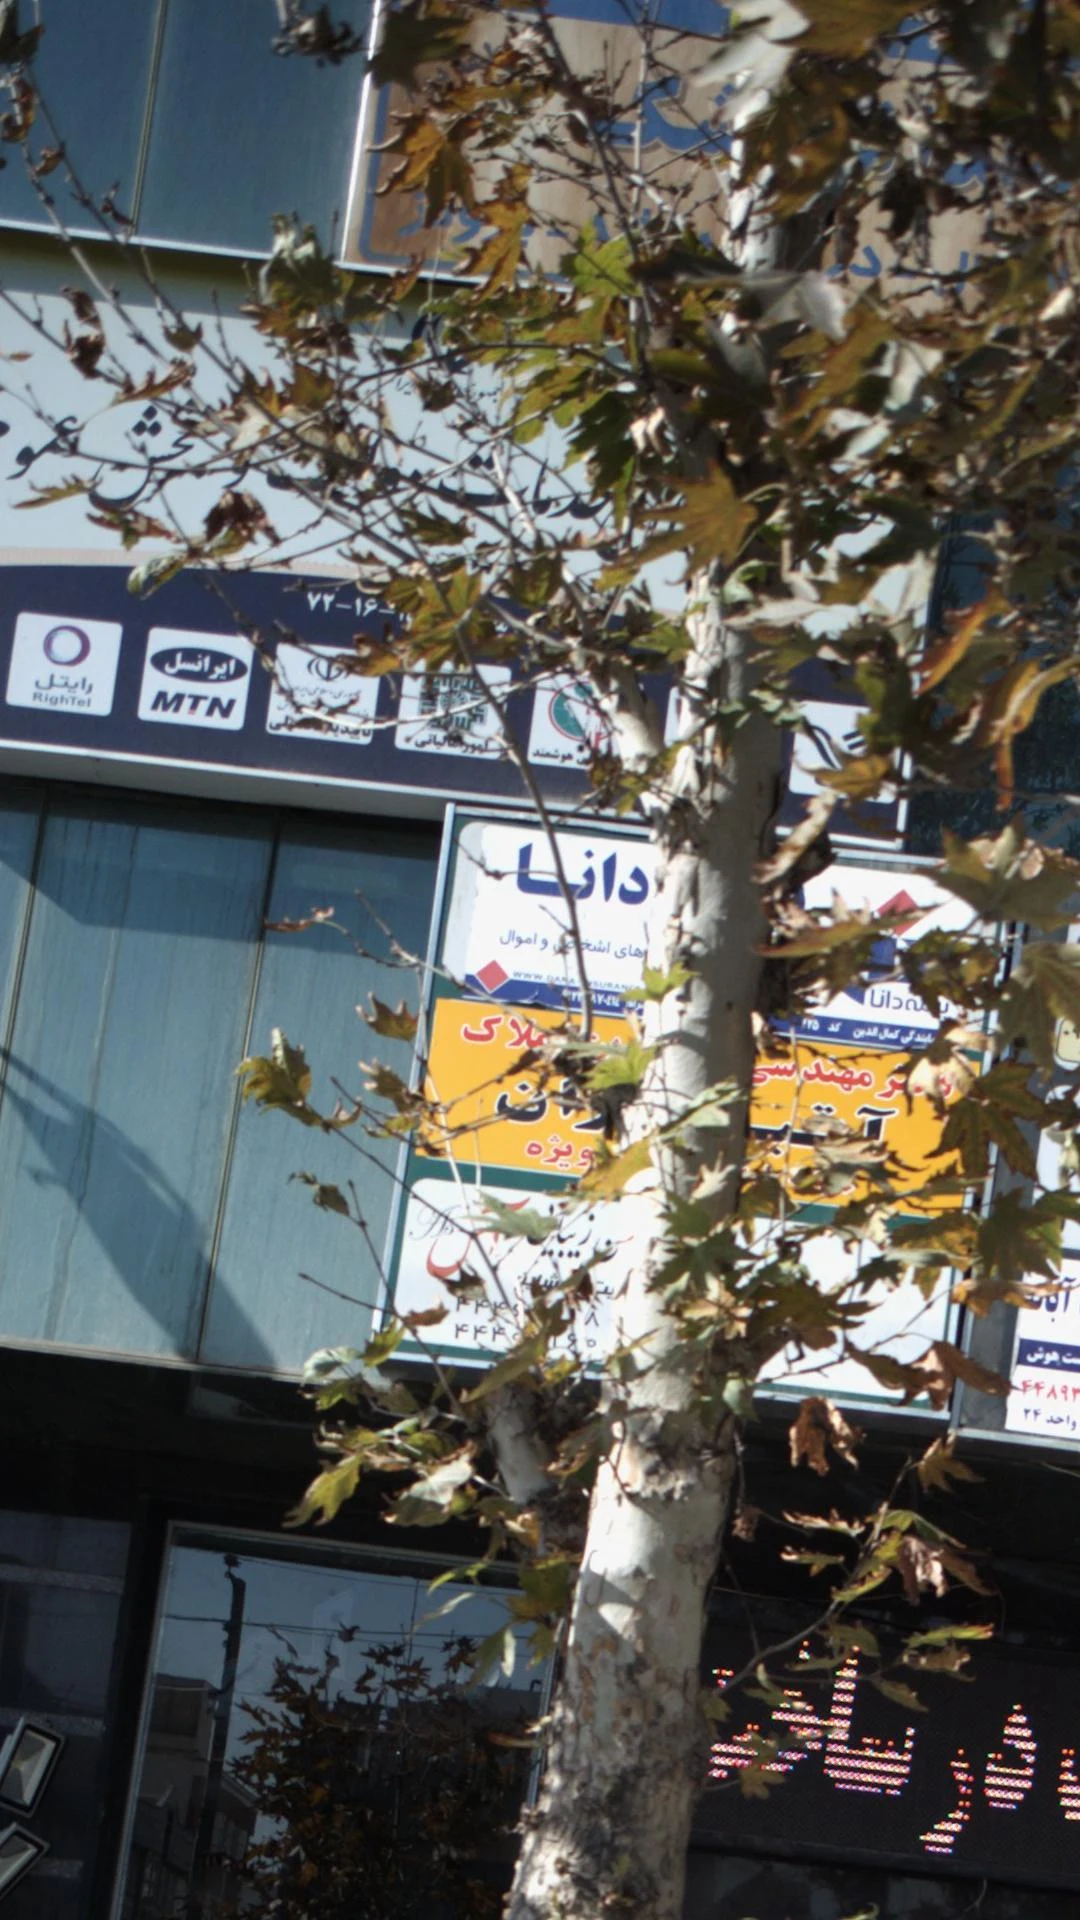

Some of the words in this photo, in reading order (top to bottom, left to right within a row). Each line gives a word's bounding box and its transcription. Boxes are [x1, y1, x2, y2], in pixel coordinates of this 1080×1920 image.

[164, 655, 236, 680] ایرانسل
[34, 673, 94, 694] رایتل
[151, 691, 236, 719] MTN
[516, 843, 650, 906] دانا
[500, 928, 538, 946] اموال
[827, 1022, 842, 1033] کد
[526, 1136, 594, 1168] ویژه
[1023, 1408, 1042, 1422] ۲۴
[1046, 1414, 1077, 1430] واحد
